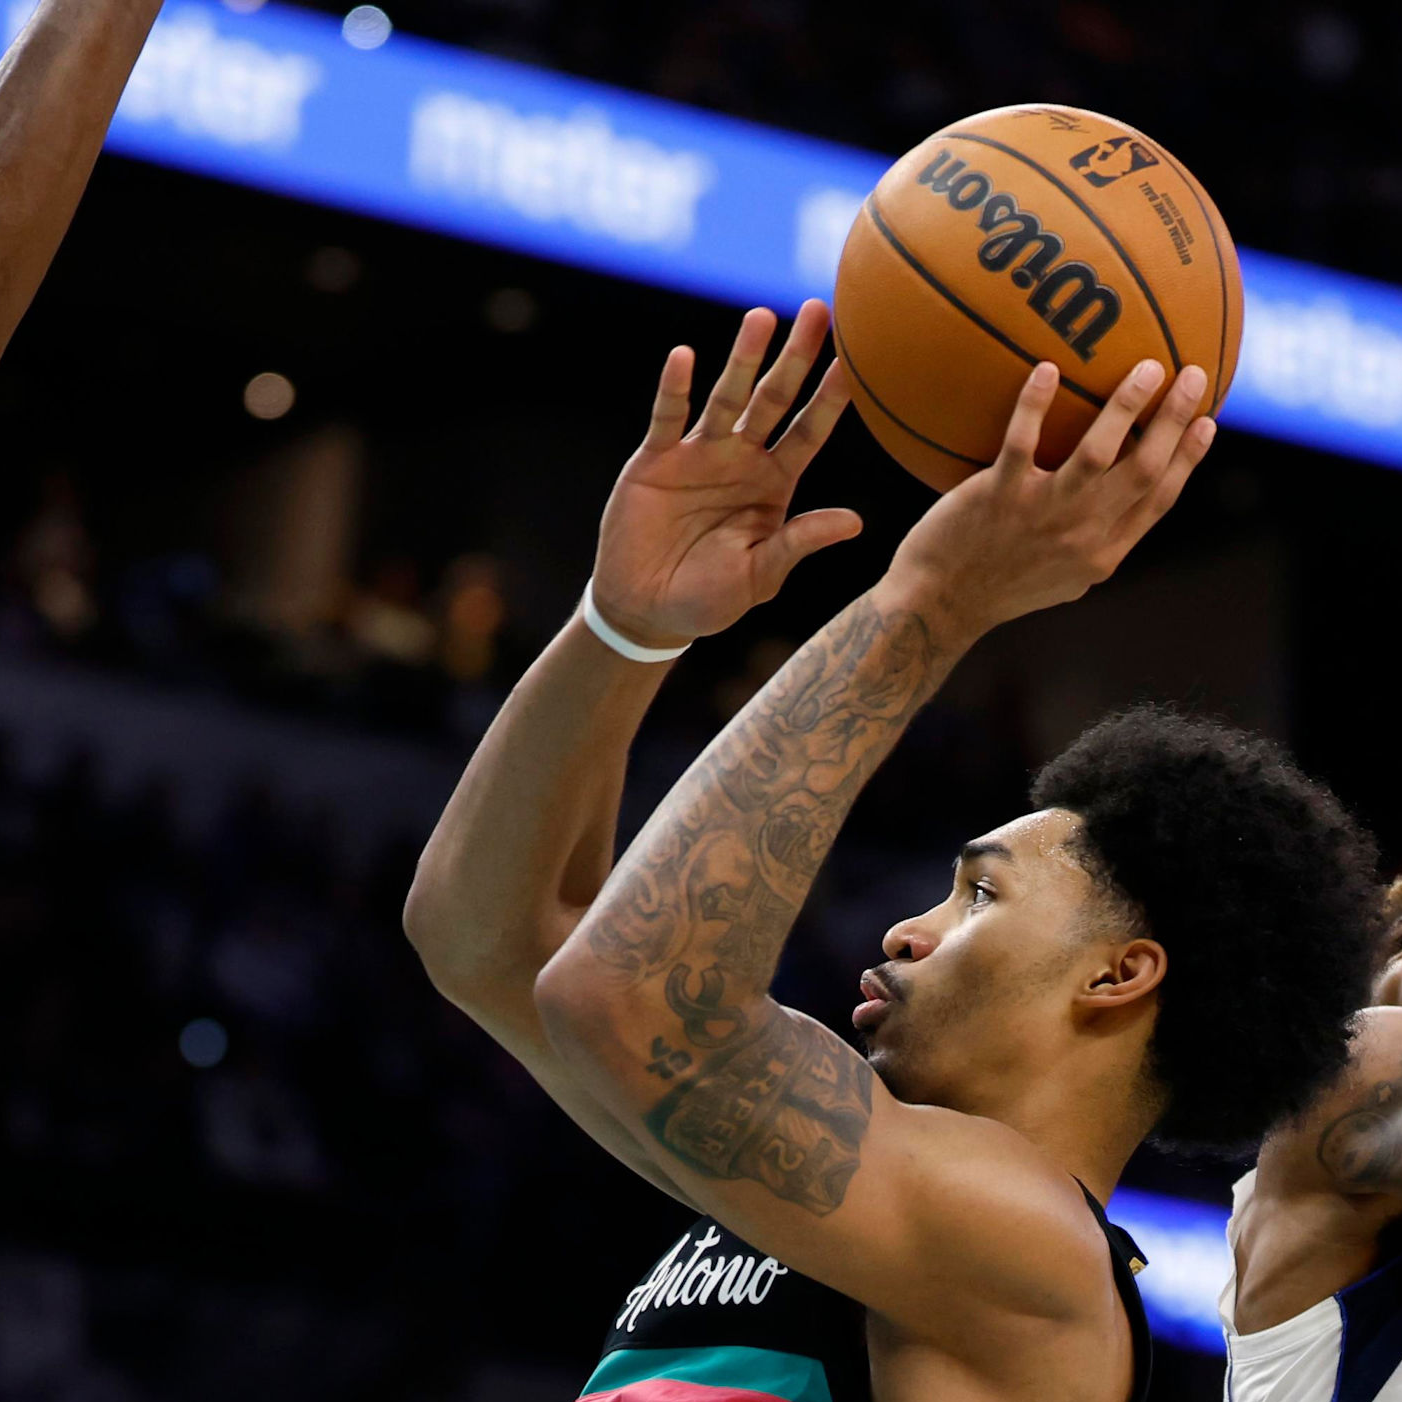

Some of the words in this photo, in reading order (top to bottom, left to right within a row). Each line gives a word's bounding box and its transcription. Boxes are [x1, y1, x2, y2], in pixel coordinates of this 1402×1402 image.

[120, 12, 325, 152] eter
[916, 149, 1123, 364] Wilson
[614, 1224, 789, 1333] Antonio
